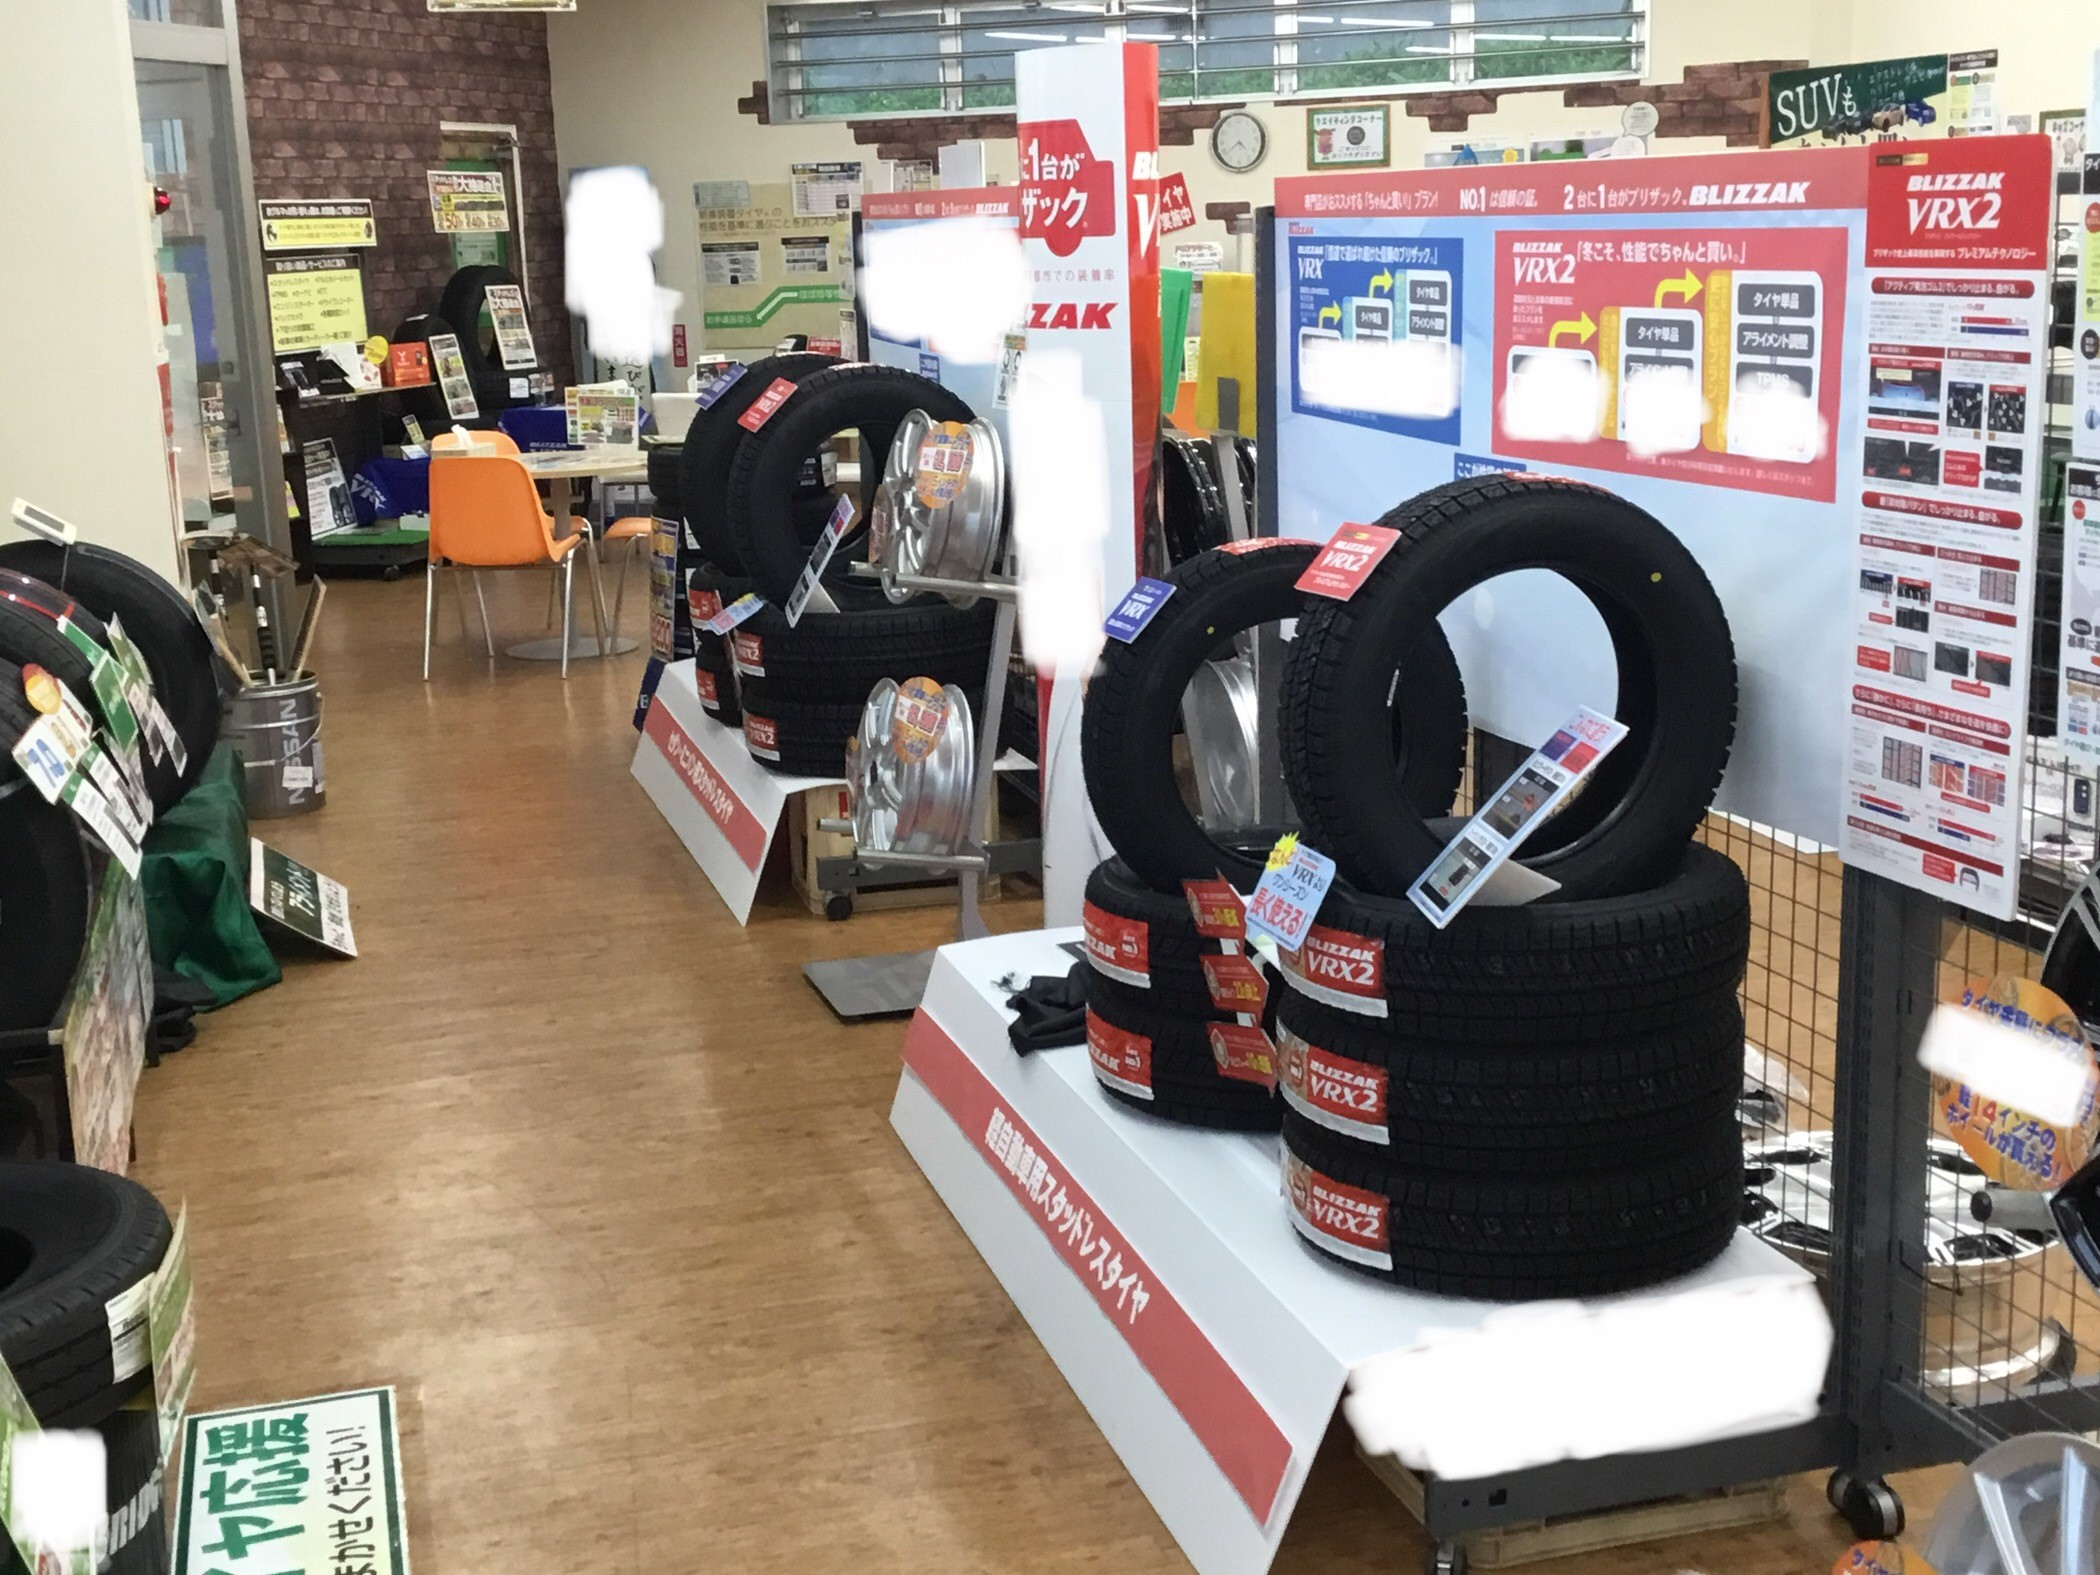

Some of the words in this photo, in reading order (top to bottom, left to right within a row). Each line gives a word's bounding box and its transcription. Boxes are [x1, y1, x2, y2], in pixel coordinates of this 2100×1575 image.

[1777, 73, 1857, 136] SUVも
[1690, 181, 1812, 206] BLIZZAK
[1906, 172, 2005, 192] BLIZZAK
[1907, 192, 2002, 236] VRX2
[1513, 242, 1563, 254] BLIZZAK
[1298, 258, 1324, 280] VRX
[1513, 254, 1576, 286] VRX2
[1753, 292, 1799, 310] タイヤ単品
[1638, 326, 1680, 342] タイヤ単品
[1743, 331, 1809, 350] アライメント調整
[1321, 551, 1368, 572] VRX2
[1117, 600, 1149, 621] VRX
[1306, 936, 1376, 962] BLIZZAK
[1307, 950, 1375, 985] VRX2
[1310, 1059, 1379, 1090] BLIZZAK
[1309, 1073, 1378, 1112] VRX2
[1313, 1186, 1382, 1217] BLIZZAK
[985, 1107, 1150, 1324] 軽自動車用スタッドレスタイヤ
[1311, 1199, 1380, 1239] VRX2
